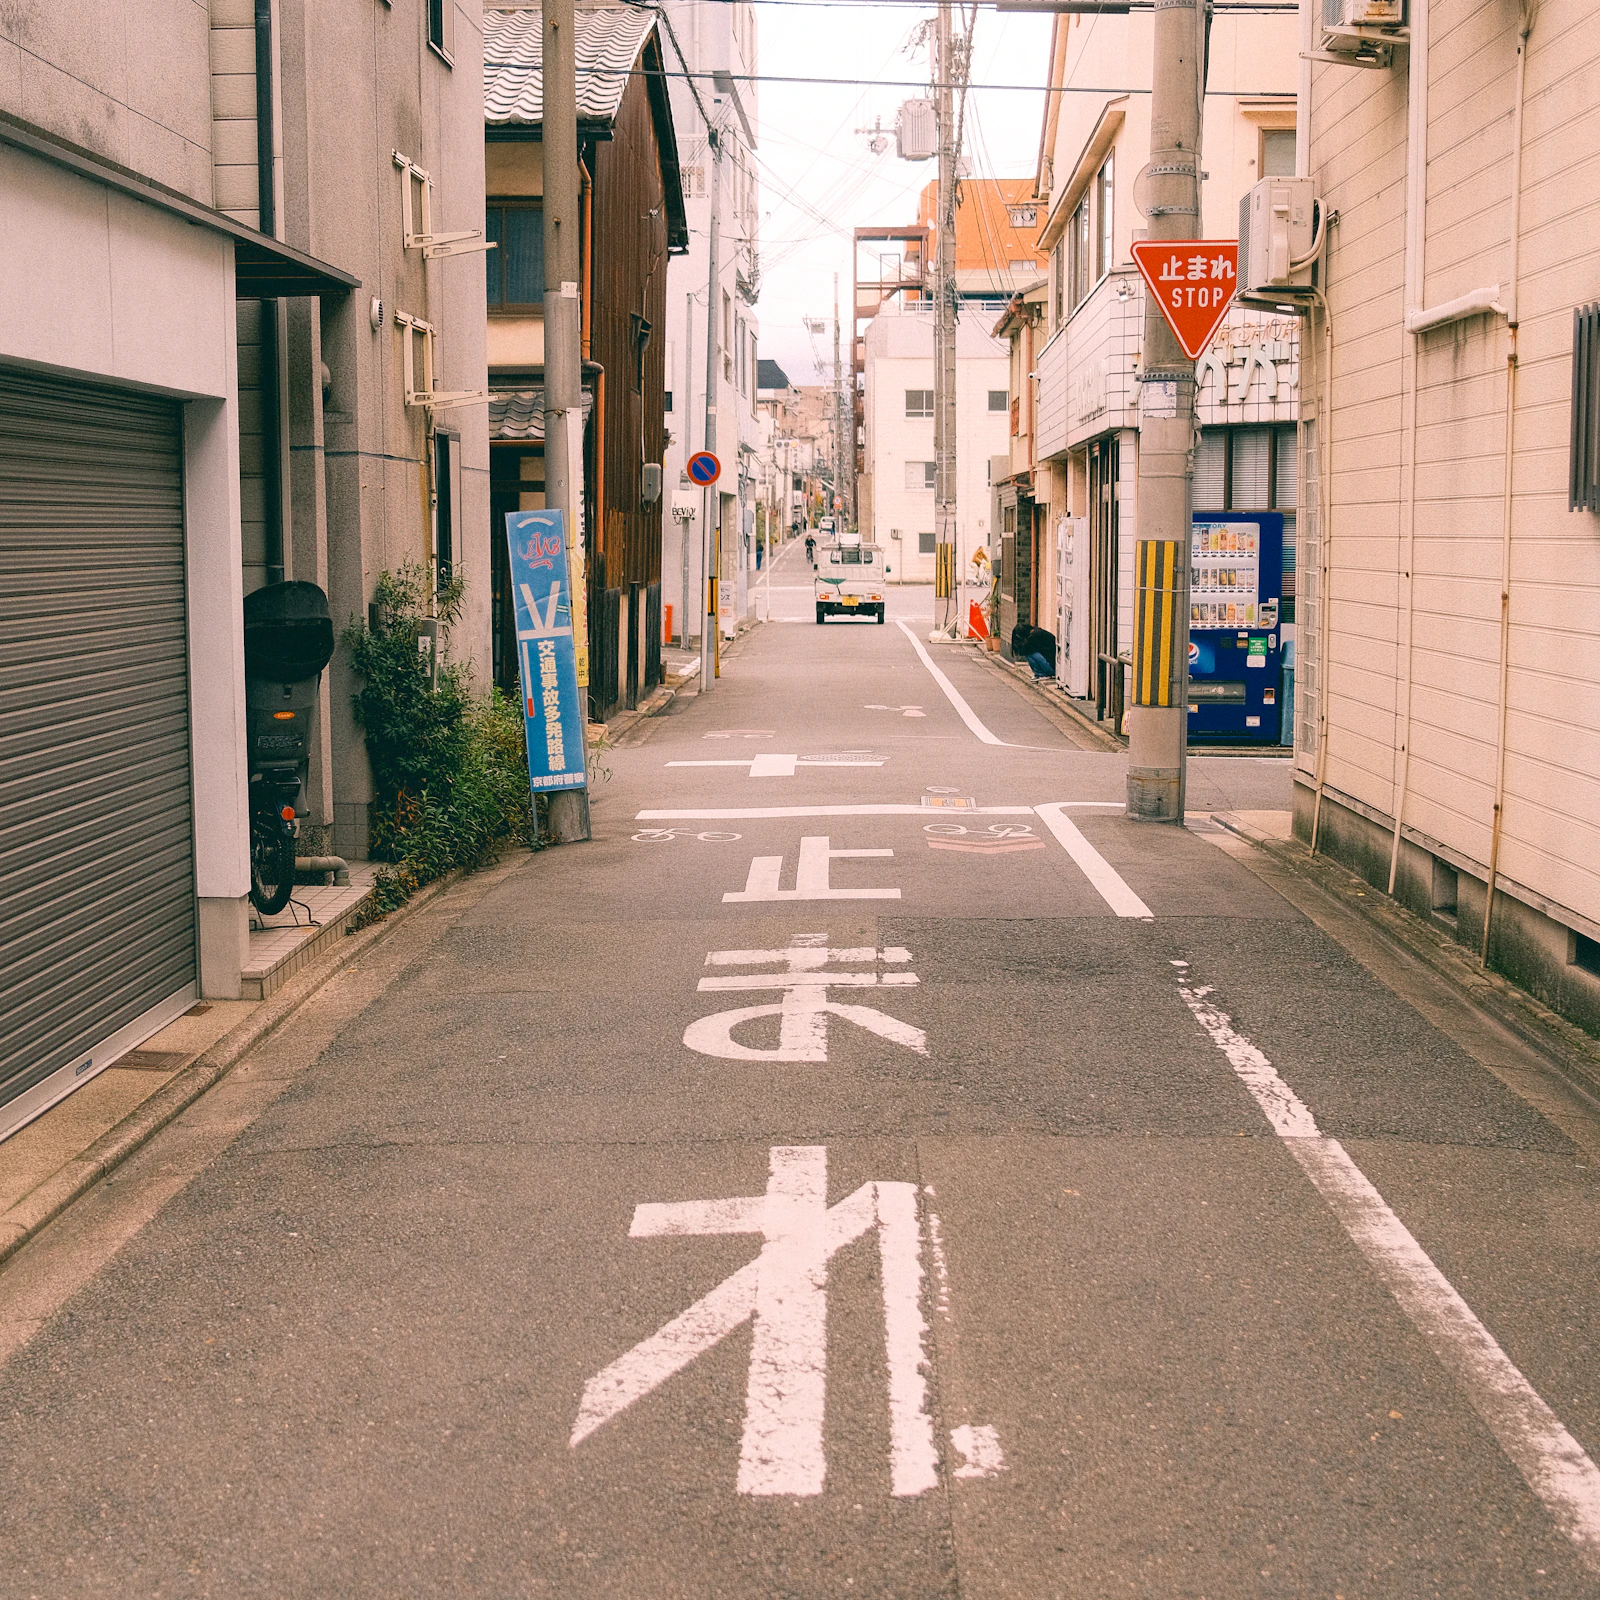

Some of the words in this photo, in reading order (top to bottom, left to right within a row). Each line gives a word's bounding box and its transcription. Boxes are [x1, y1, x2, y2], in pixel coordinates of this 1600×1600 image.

[1158, 254, 1236, 281] 止まれ
[1171, 287, 1224, 308] STOP
[537, 639, 566, 772] 交通事故多発路線
[531, 772, 585, 788] 京都府警察
